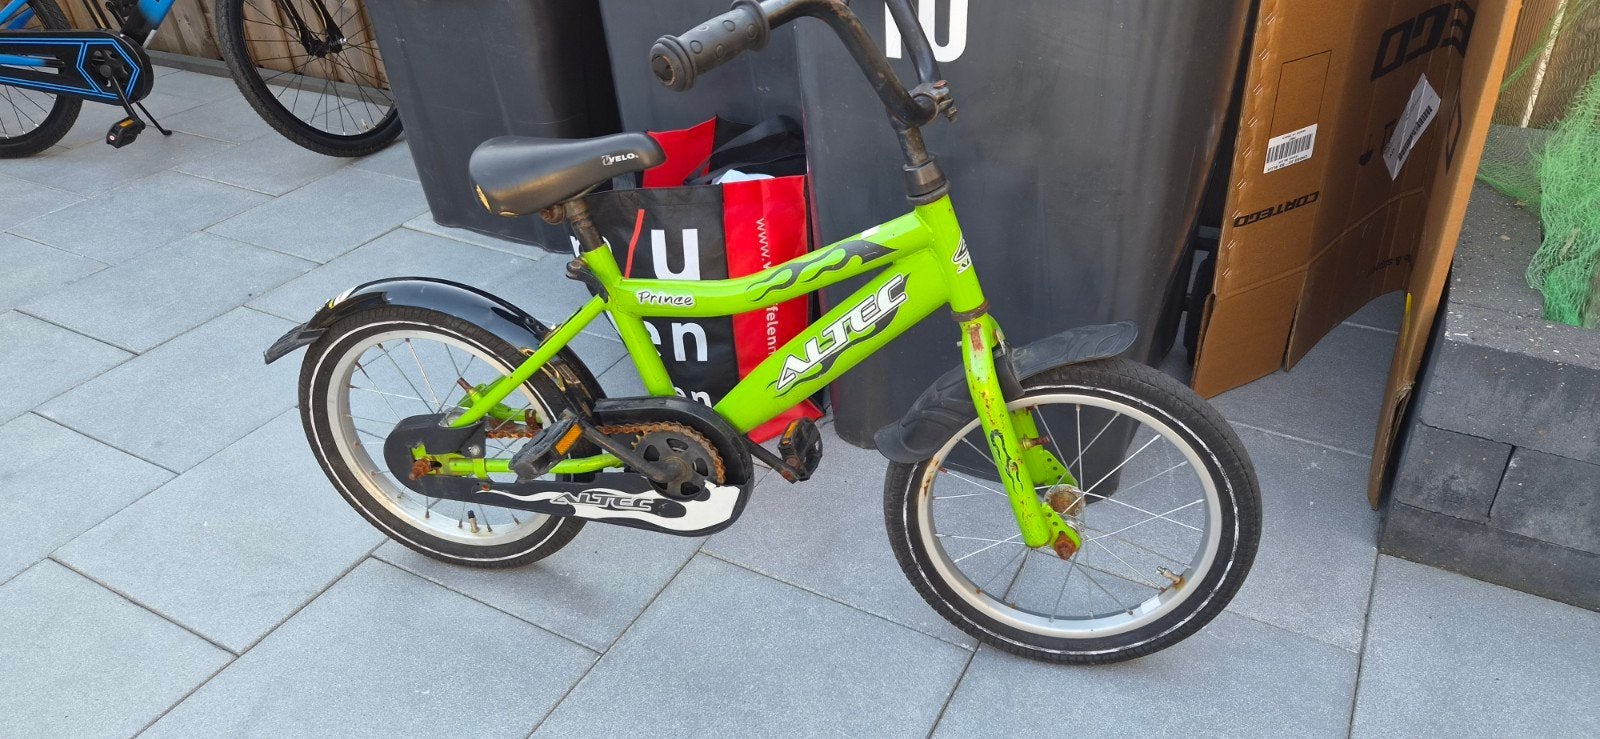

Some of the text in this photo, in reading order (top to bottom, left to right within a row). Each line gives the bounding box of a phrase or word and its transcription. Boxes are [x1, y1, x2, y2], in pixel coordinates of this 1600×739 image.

[1233, 191, 1320, 228] CORTEGO
[637, 290, 695, 306] Prince
[776, 274, 908, 392] ALTEC
[550, 491, 655, 512] ALTEC
